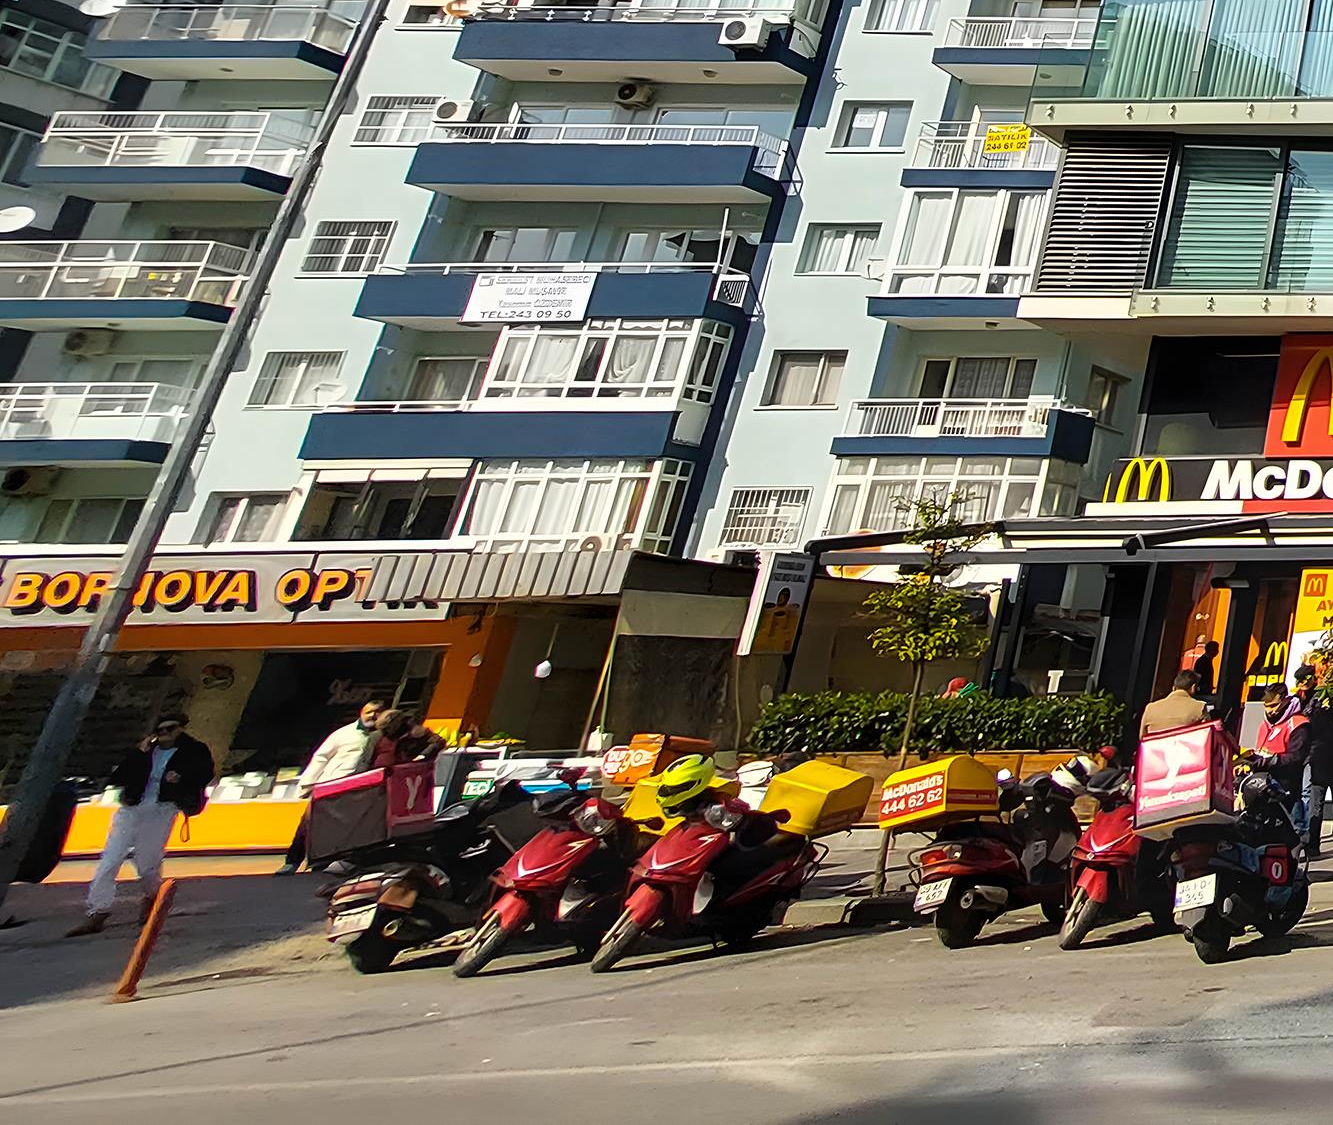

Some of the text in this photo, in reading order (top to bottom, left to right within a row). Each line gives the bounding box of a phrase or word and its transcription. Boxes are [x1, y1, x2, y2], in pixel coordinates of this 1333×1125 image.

[536, 310, 552, 319] 09
[556, 310, 572, 319] 50
[881, 775, 943, 801] McDonald's
[880, 788, 943, 815] 444 62 62
